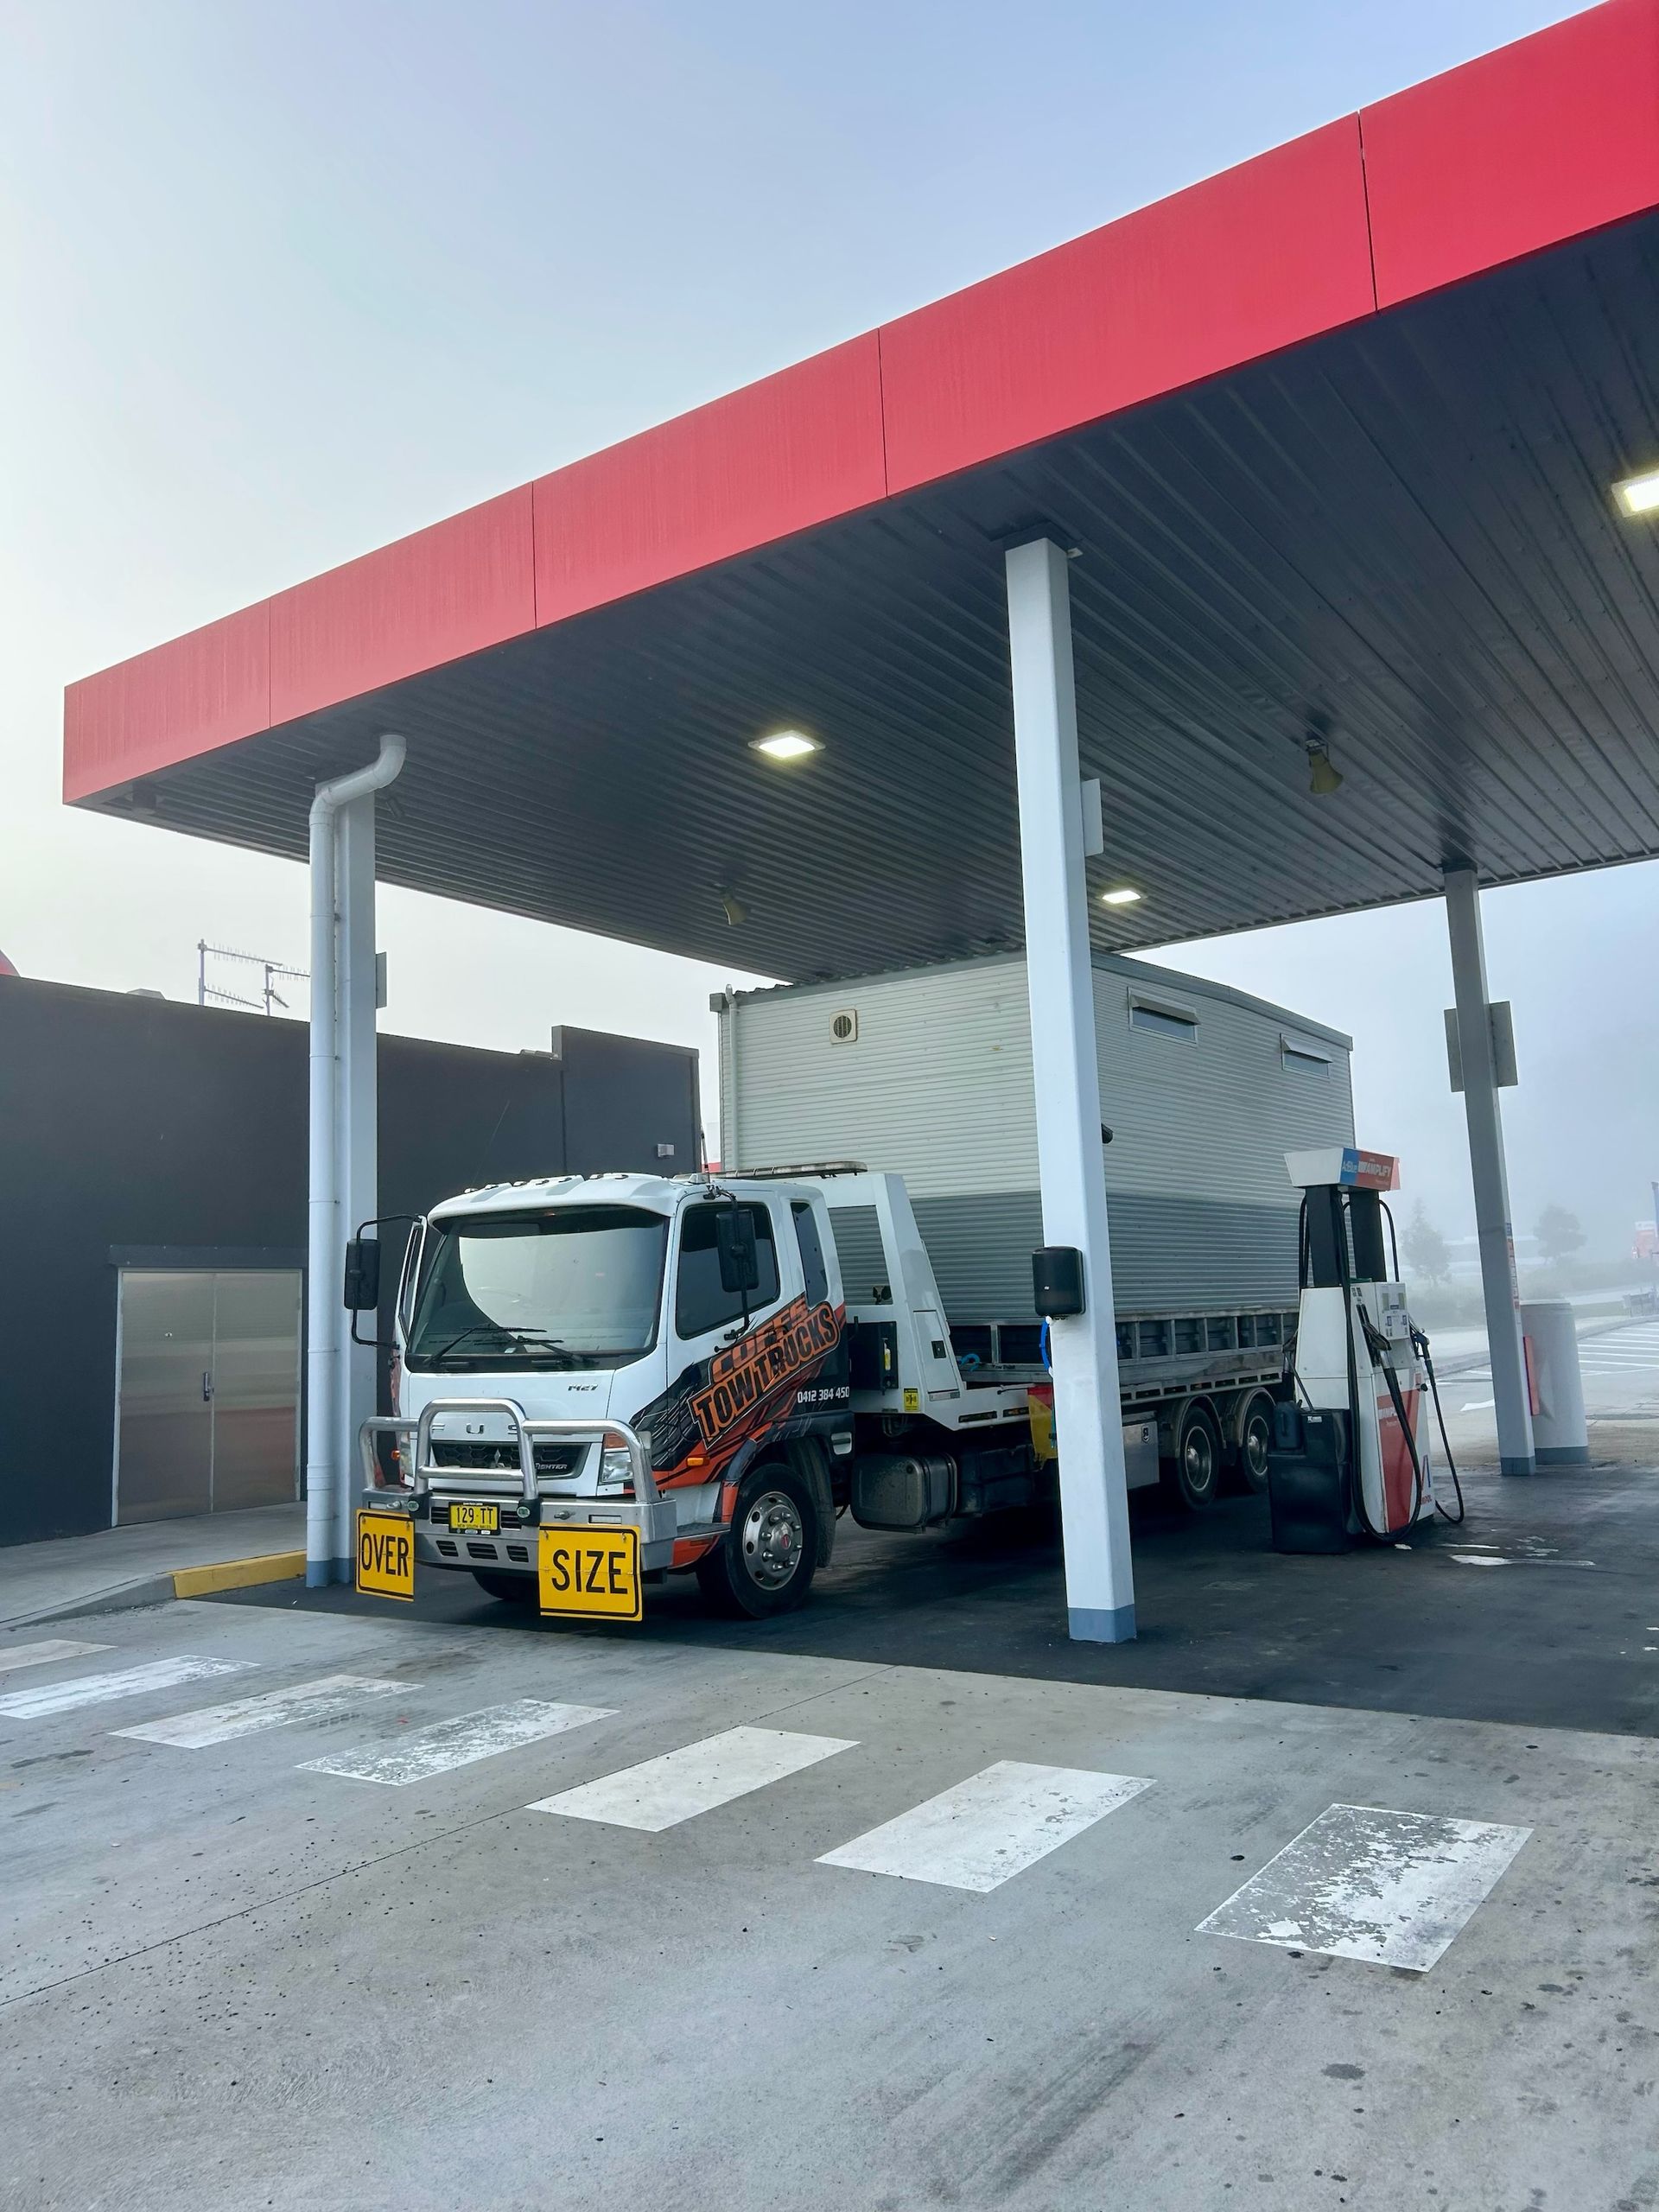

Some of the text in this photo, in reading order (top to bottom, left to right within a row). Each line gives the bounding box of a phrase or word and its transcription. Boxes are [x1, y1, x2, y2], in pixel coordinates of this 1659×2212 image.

[696, 1306, 836, 1436] TOW TRUCKS
[797, 1386, 849, 1404] 0412 384 450
[432, 1423, 518, 1434] FUS
[457, 1507, 493, 1524] 129 TT
[361, 1533, 410, 1577] OVER
[551, 1549, 628, 1594] SIZE
